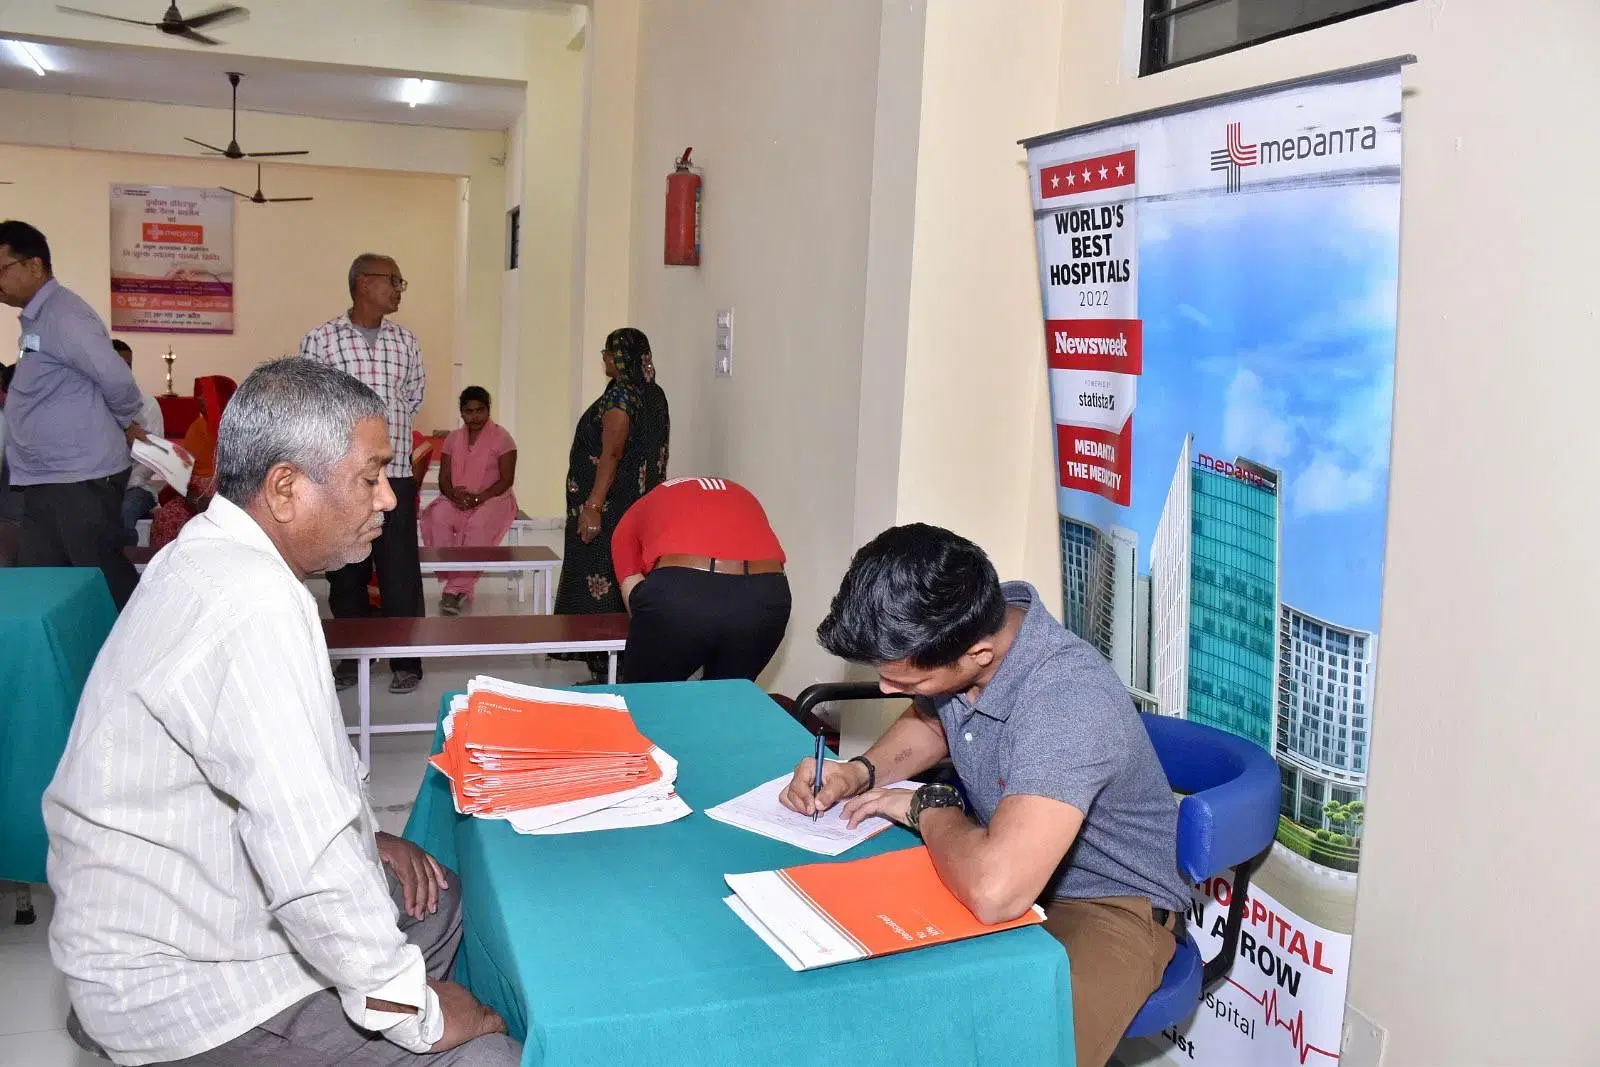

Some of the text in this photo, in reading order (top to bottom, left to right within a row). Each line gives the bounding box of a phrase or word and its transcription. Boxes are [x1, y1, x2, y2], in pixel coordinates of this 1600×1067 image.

[1055, 204, 1124, 235] WORLD'S
[1071, 234, 1113, 259] BEST
[1050, 259, 1131, 286] HOSPITALS
[1079, 291, 1109, 307] 2022
[1054, 331, 1128, 357] Newsweek
[1079, 391, 1108, 409] statista
[1074, 439, 1115, 463] MEDANTA
[1067, 460, 1122, 491] THE MEDICITY
[1195, 876, 1334, 975] OPITAL
[1240, 930, 1302, 998] ROW
[1198, 989, 1256, 1041] spital
